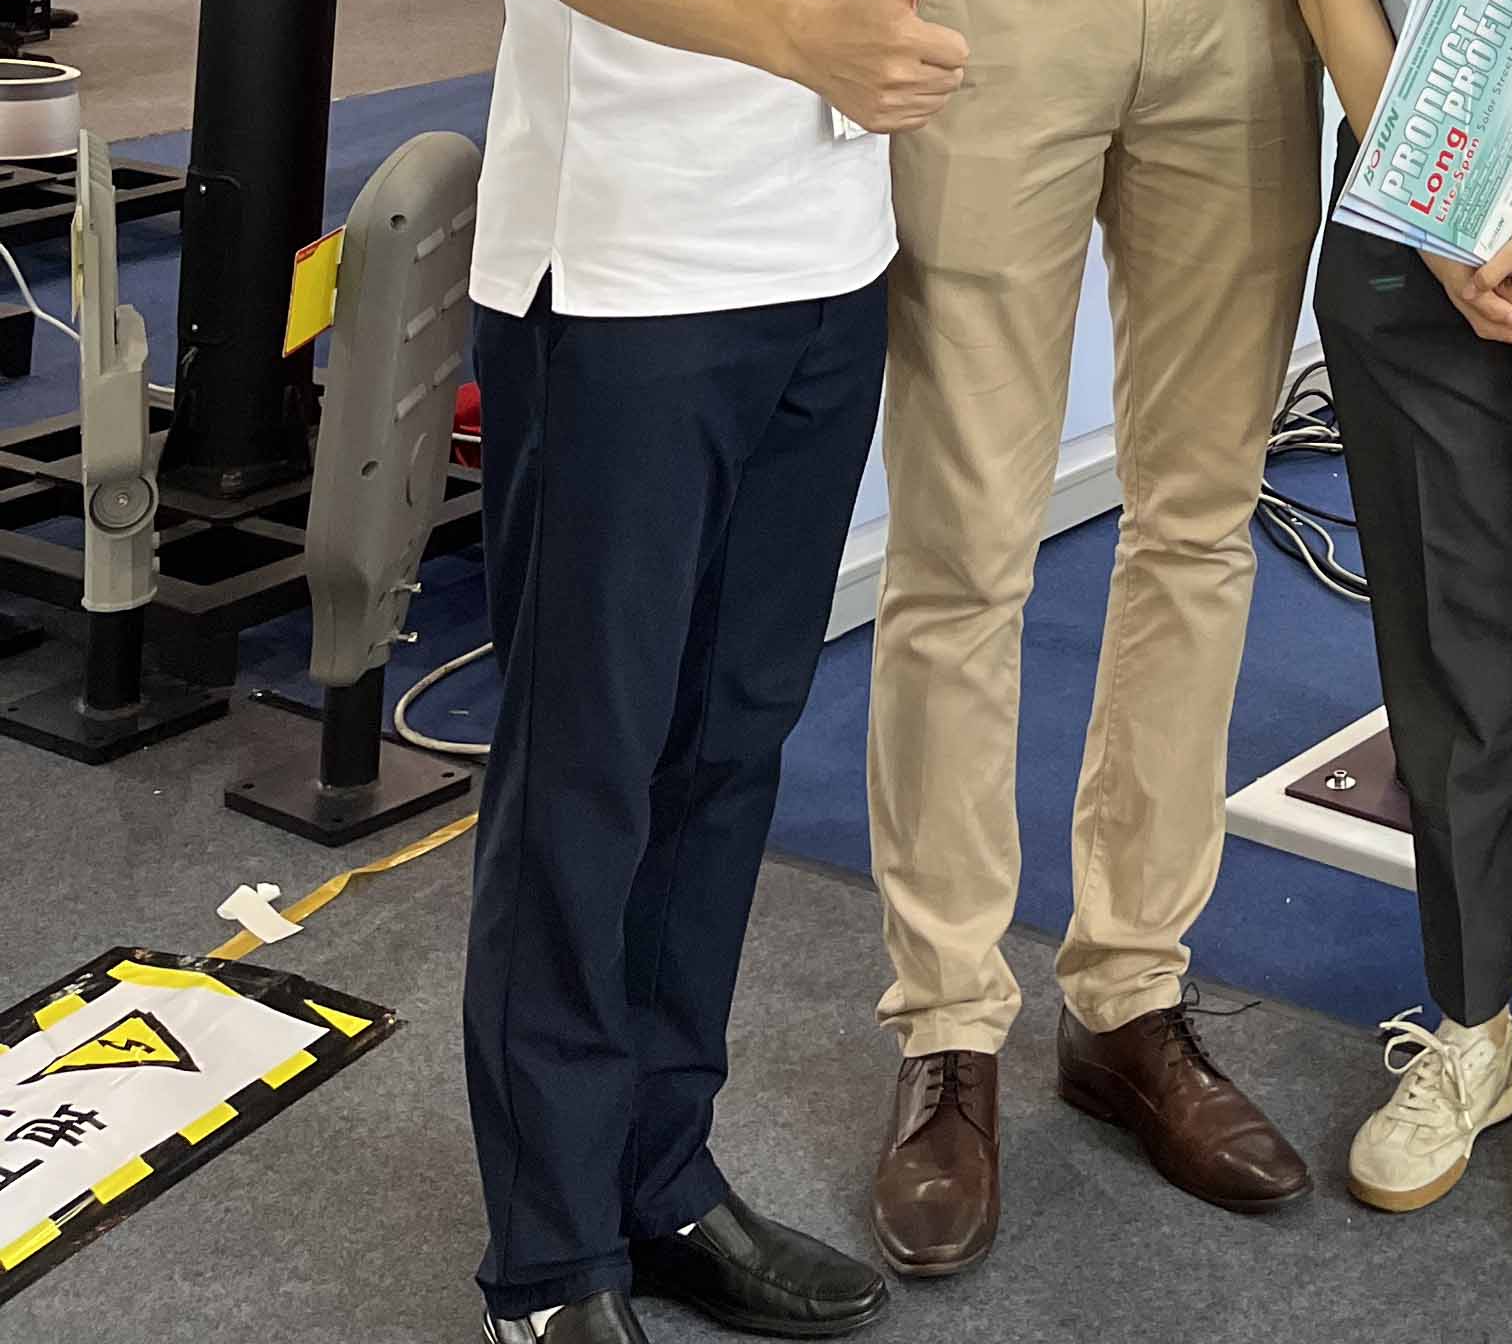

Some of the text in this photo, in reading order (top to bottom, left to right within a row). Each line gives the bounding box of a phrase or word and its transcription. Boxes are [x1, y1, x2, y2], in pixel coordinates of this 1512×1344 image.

[1363, 106, 1400, 187] BOSUN
[1379, 4, 1481, 205] PRODUCT
[1476, 95, 1497, 132] Solar
[1409, 126, 1469, 215] Long
